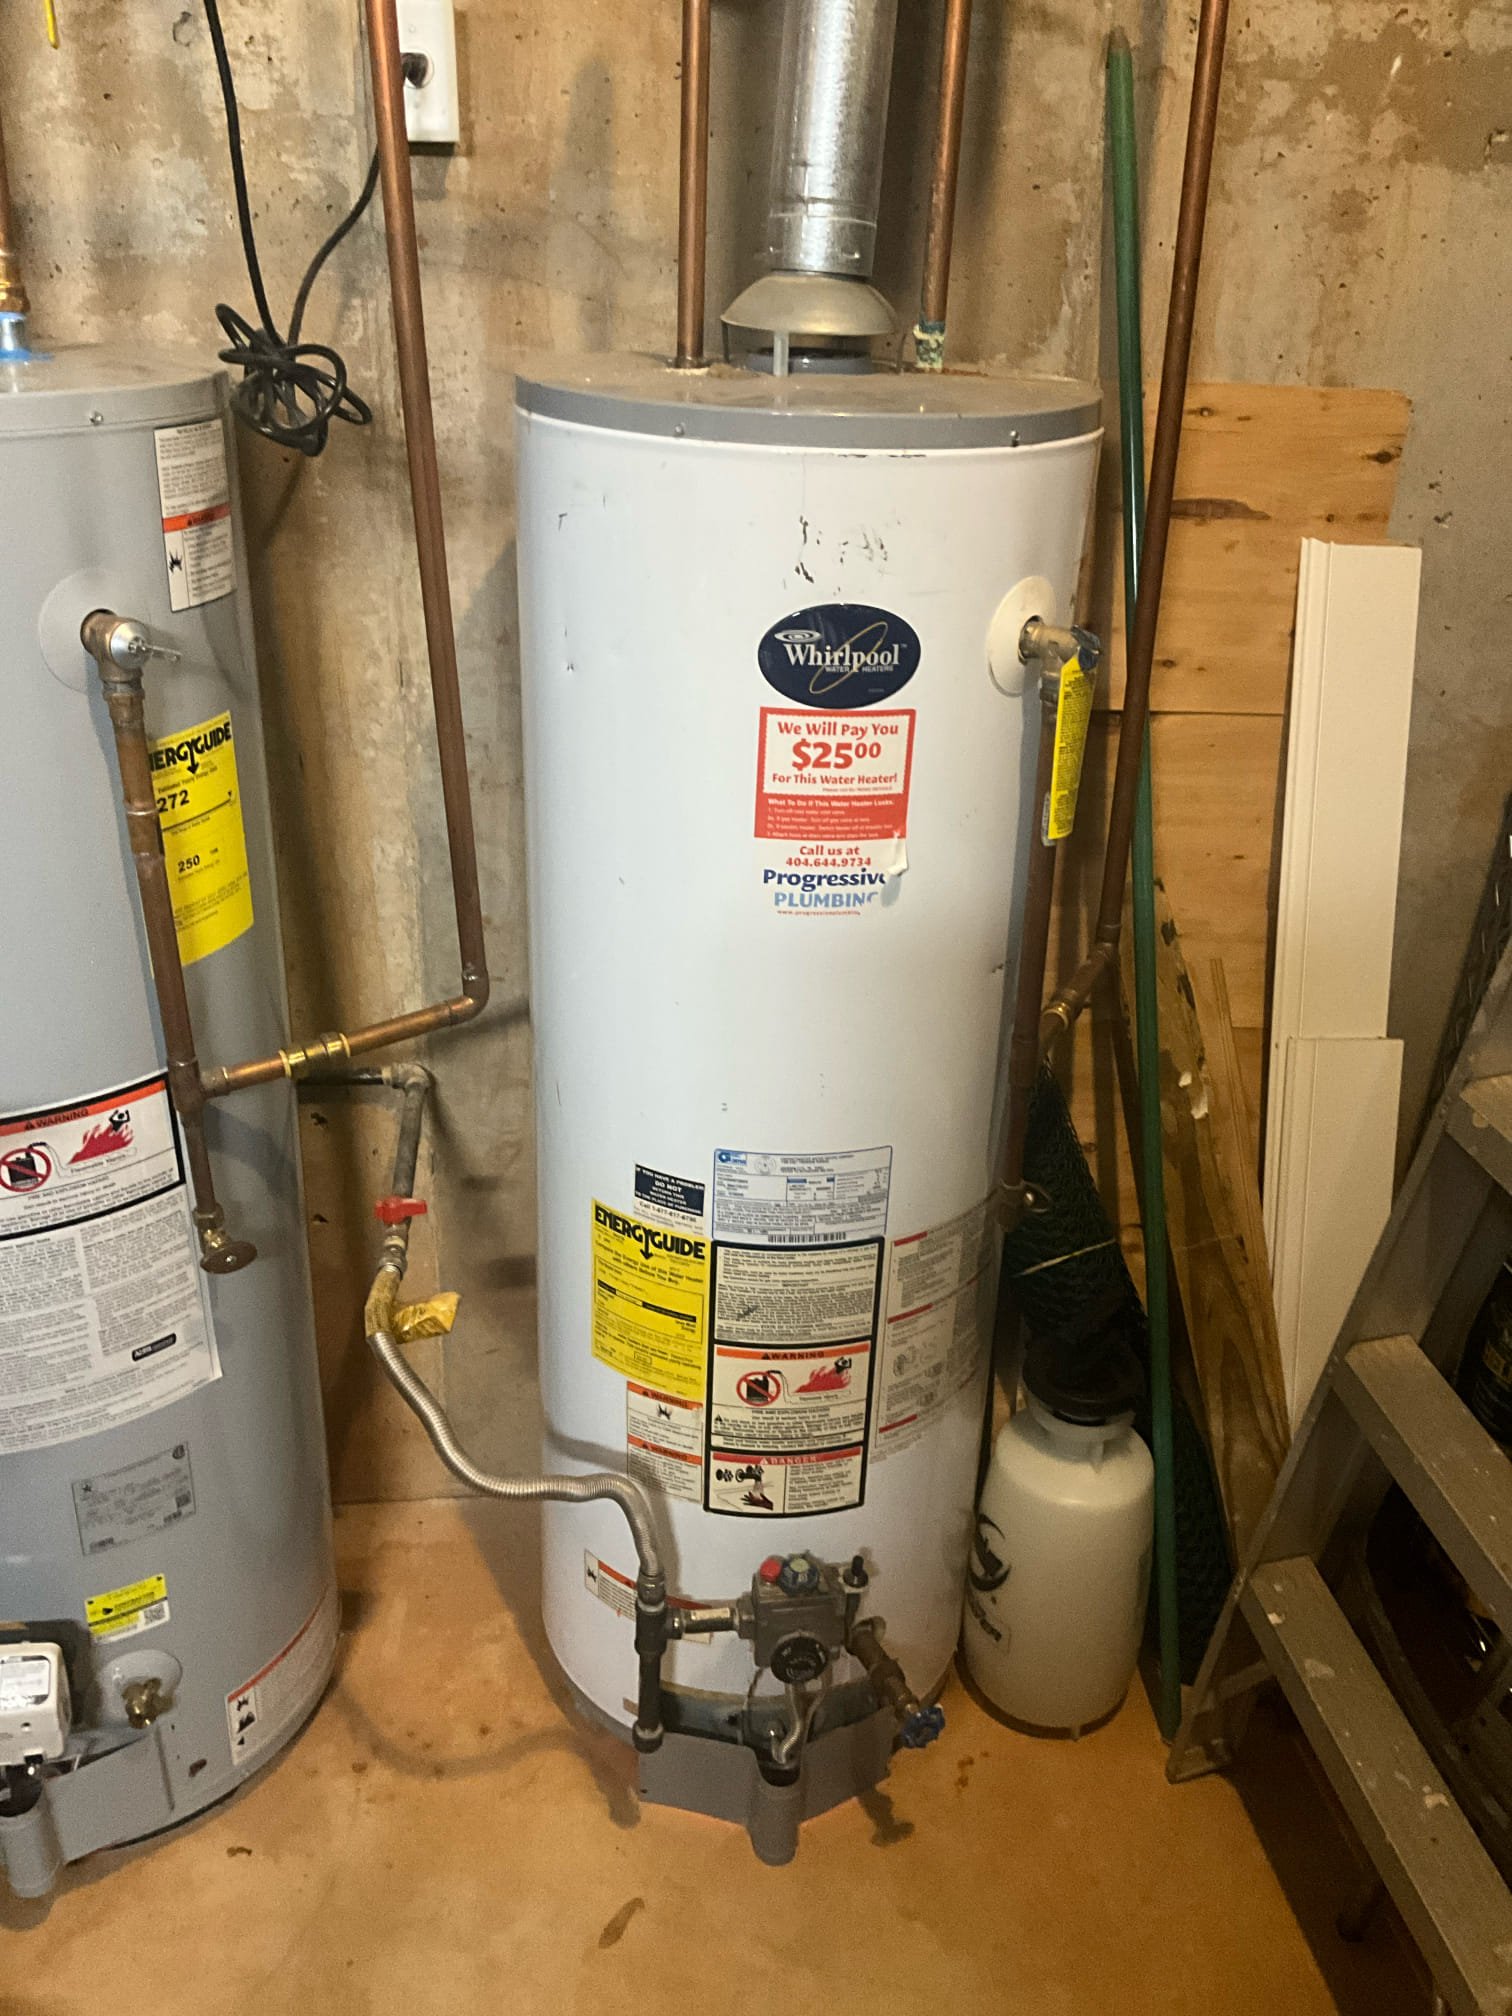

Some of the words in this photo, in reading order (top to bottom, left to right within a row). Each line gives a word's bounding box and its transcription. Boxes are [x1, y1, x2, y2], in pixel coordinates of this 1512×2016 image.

[784, 643, 899, 673] Whirlpool
[777, 721, 802, 735] We
[806, 721, 837, 736] Will
[841, 723, 868, 741] Pay
[872, 723, 899, 735] You
[772, 773, 792, 784] For
[793, 774, 817, 785] This
[820, 774, 856, 785] Water
[857, 772, 898, 784] Heater!
[157, 790, 190, 813] 272
[799, 845, 824, 856] Call
[827, 846, 843, 856] us
[846, 845, 861, 856] at
[178, 854, 201, 874] 250
[785, 857, 872, 868] 404.644.9734
[37, 1108, 90, 1129] WARNING
[595, 1204, 706, 1260] ENERGYGUIDE
[770, 1351, 825, 1360] WARNING
